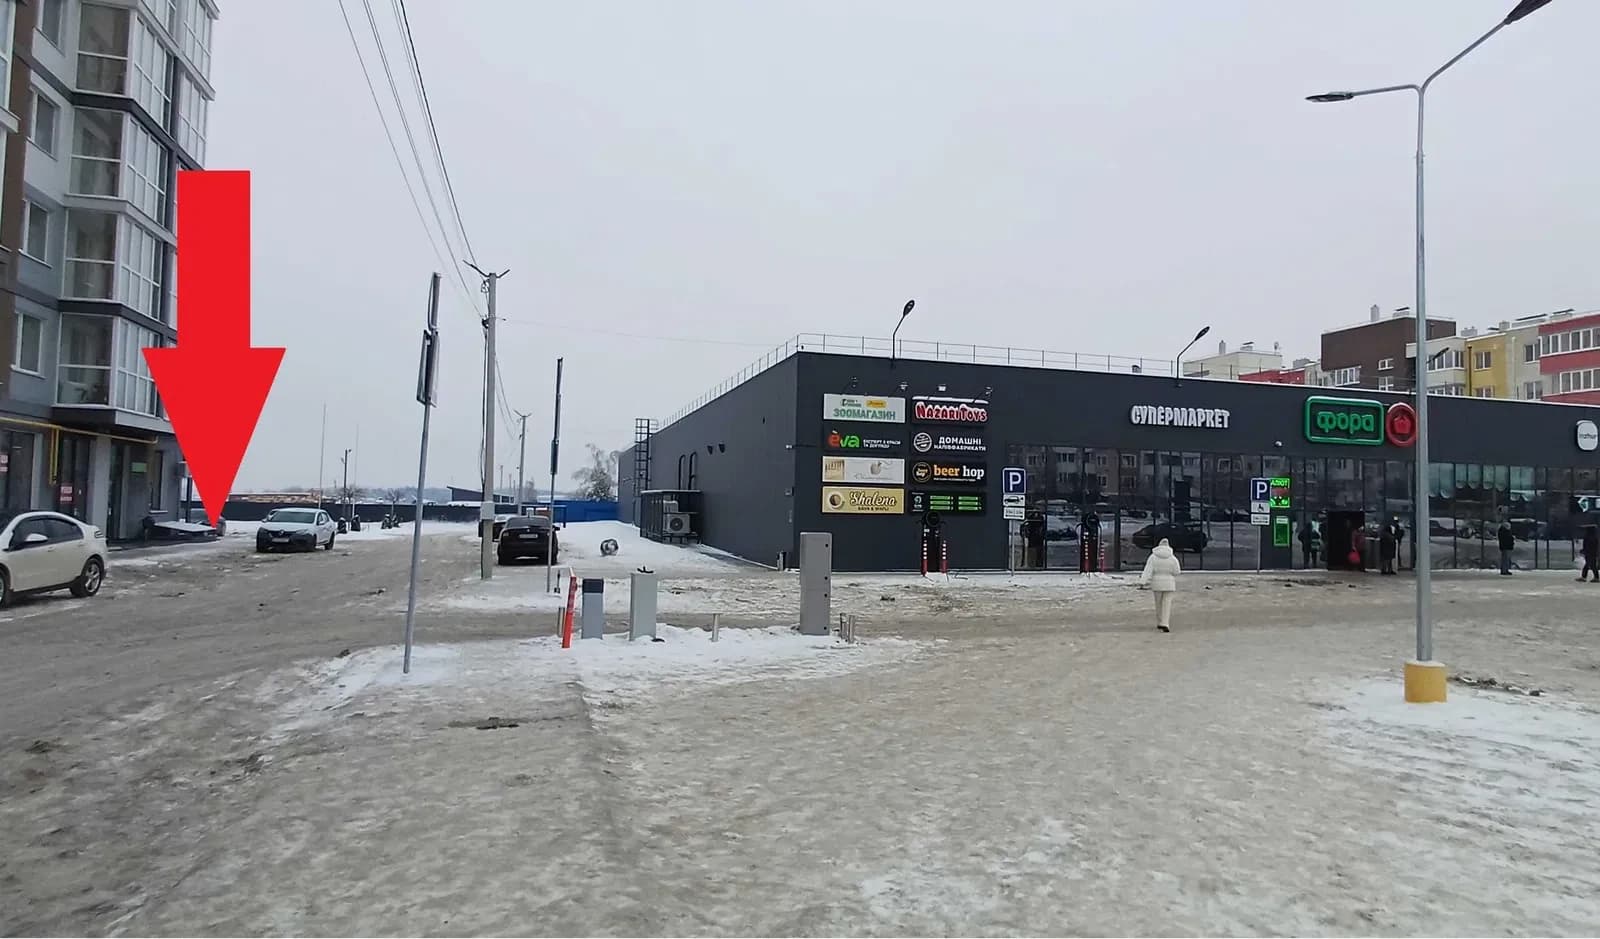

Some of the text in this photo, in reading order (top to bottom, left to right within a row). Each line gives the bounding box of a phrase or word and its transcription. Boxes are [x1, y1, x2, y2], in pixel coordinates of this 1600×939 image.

[833, 408, 896, 420] ЗООМАГАЗИН
[1131, 405, 1231, 428] СУПЕРМАРКЕТ
[1317, 410, 1374, 434] фора
[939, 436, 981, 445] ДОМАШНІ
[933, 464, 985, 480] beer hop
[1009, 472, 1021, 491] P
[1256, 481, 1267, 499] P
[850, 490, 897, 507] Shalena
